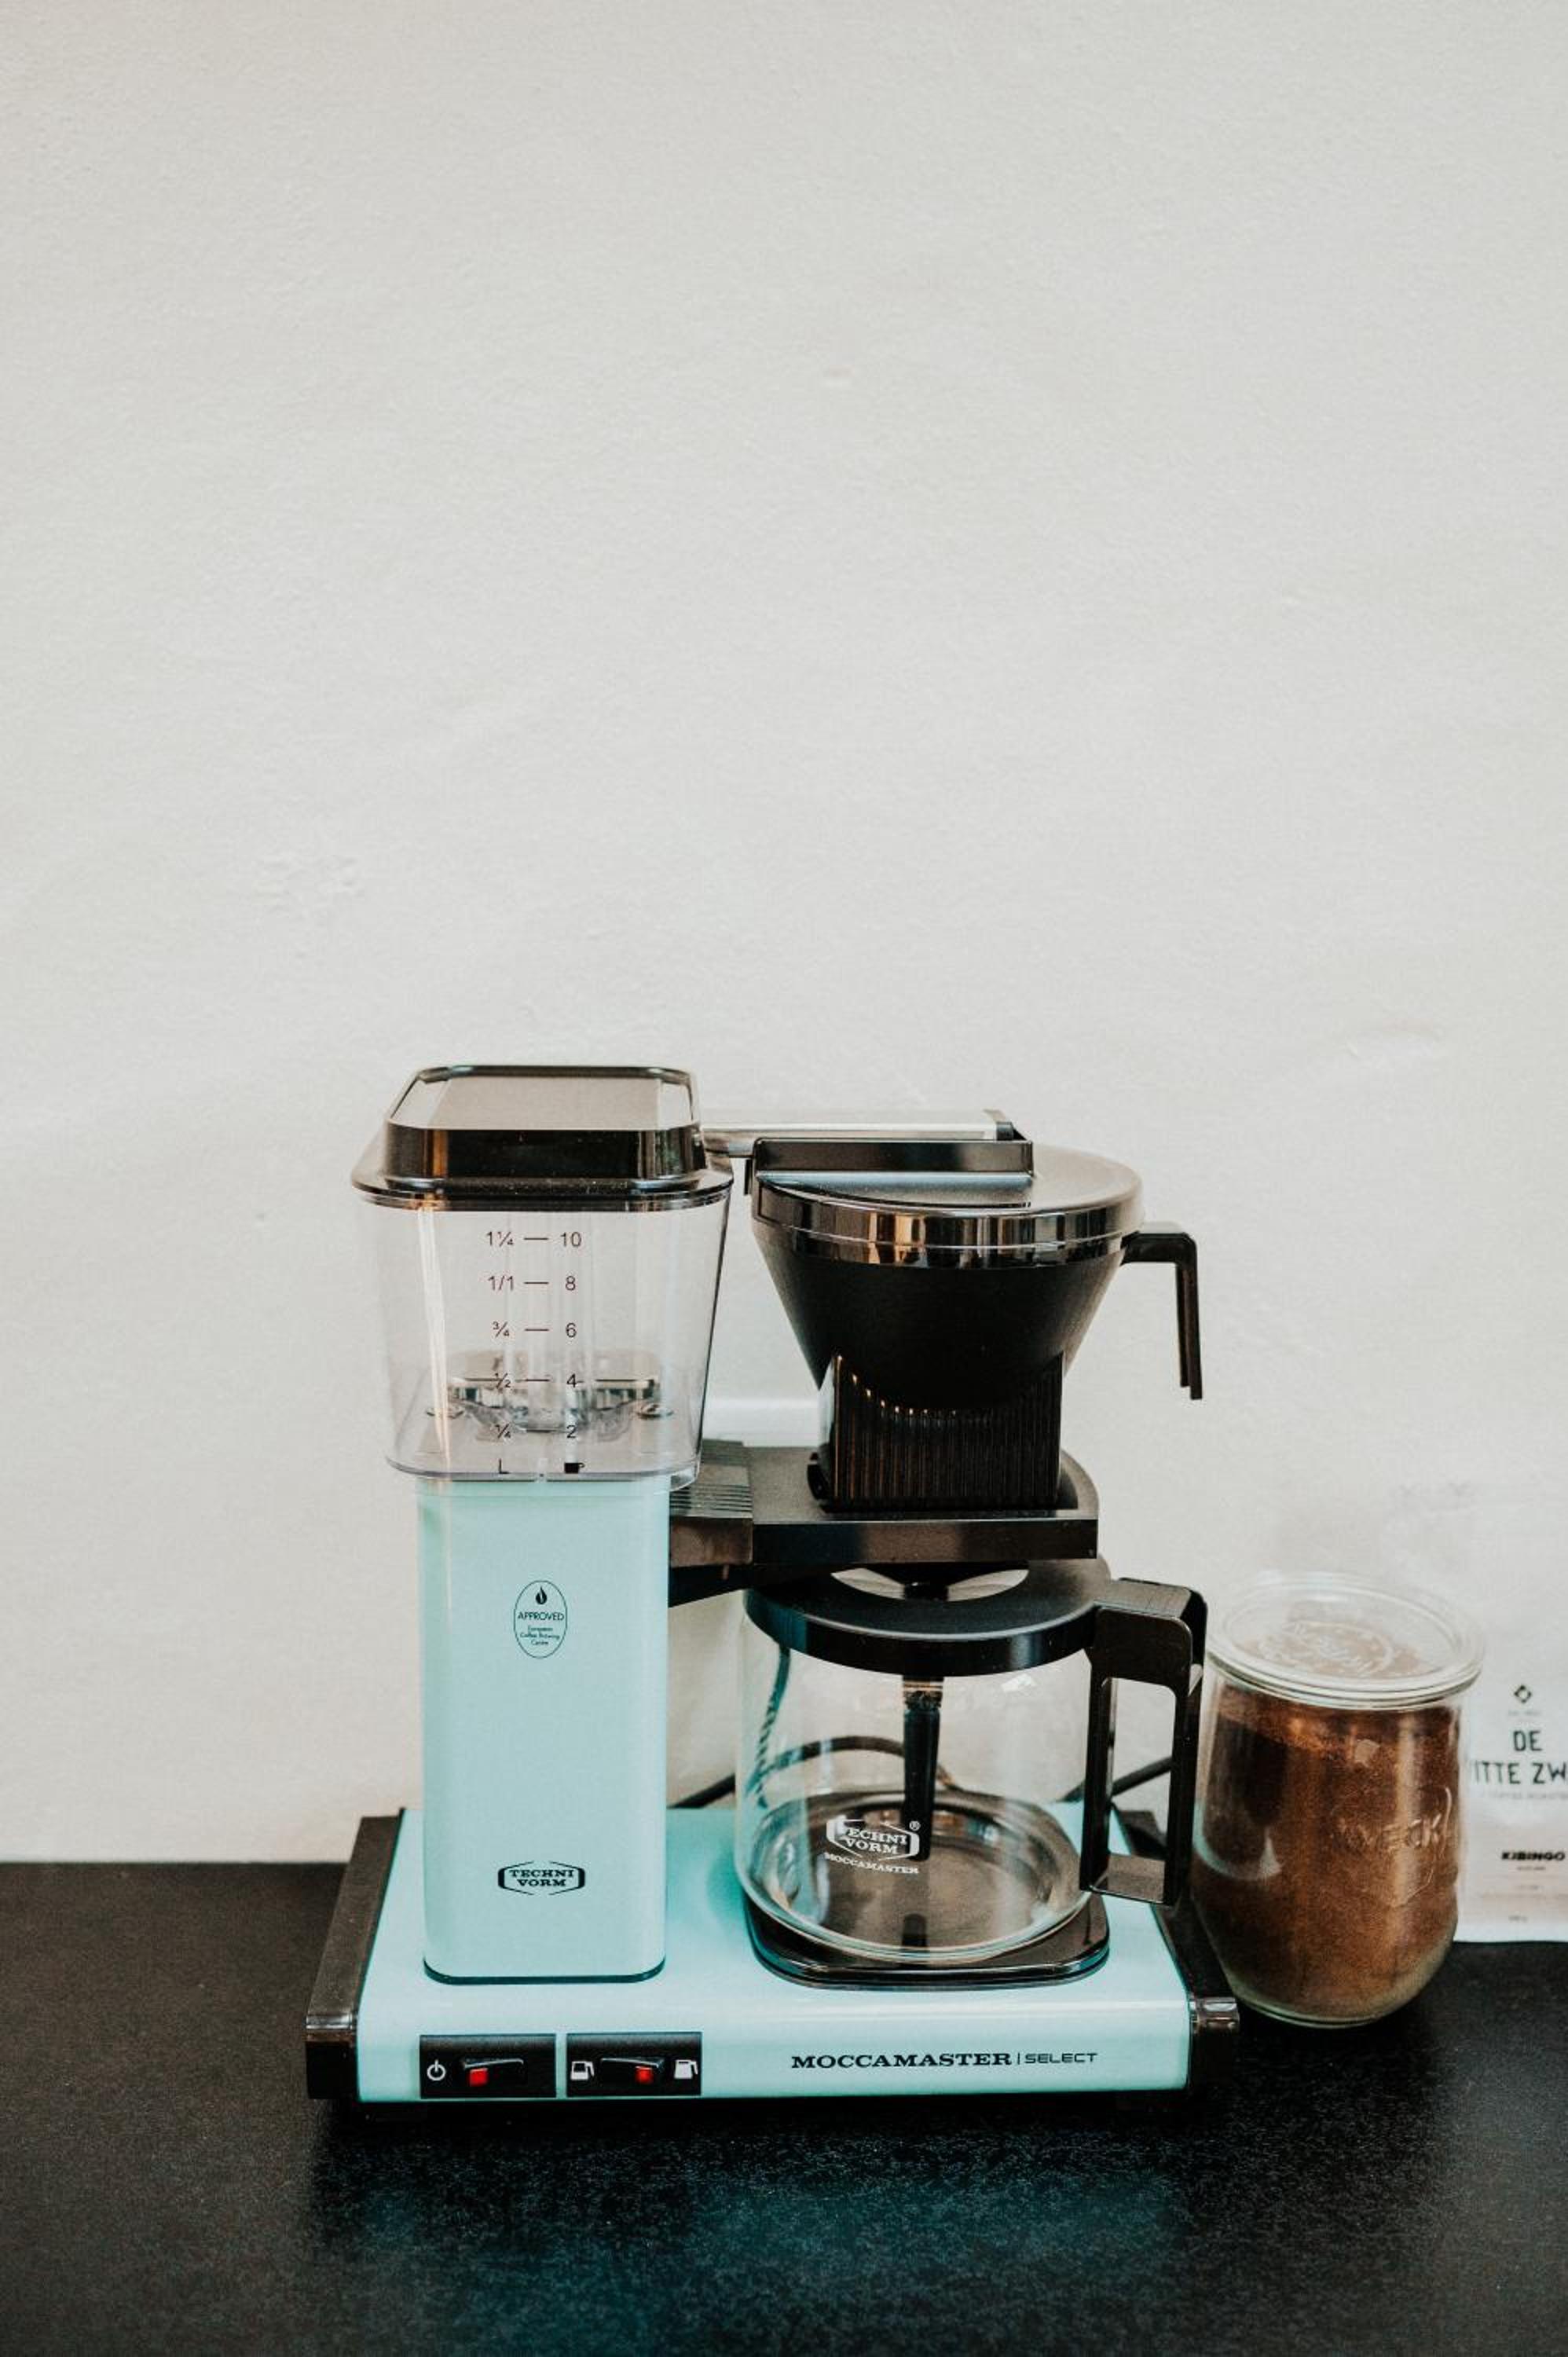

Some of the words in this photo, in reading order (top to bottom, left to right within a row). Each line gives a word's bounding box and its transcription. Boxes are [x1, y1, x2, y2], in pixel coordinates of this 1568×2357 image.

[560, 1231, 582, 1248] 10
[487, 1275, 514, 1291] 1/1
[565, 1275, 576, 1291] 8
[565, 1322, 577, 1338] 6
[566, 1373, 577, 1388] 4
[566, 1424, 577, 1439] 2
[498, 1458, 510, 1474] L
[518, 1611, 565, 1621] APPROVED
[1514, 1730, 1542, 1752] DE
[1469, 1760, 1521, 1784] ITTE
[841, 1836, 899, 1855] VORM
[824, 1853, 918, 1875] MOCCAMASTER
[508, 1869, 574, 1878] TECHNI
[516, 1879, 566, 1887] VORM
[791, 2053, 1011, 2069] MOCCAMASTER
[1024, 2052, 1098, 2064] SELECT
